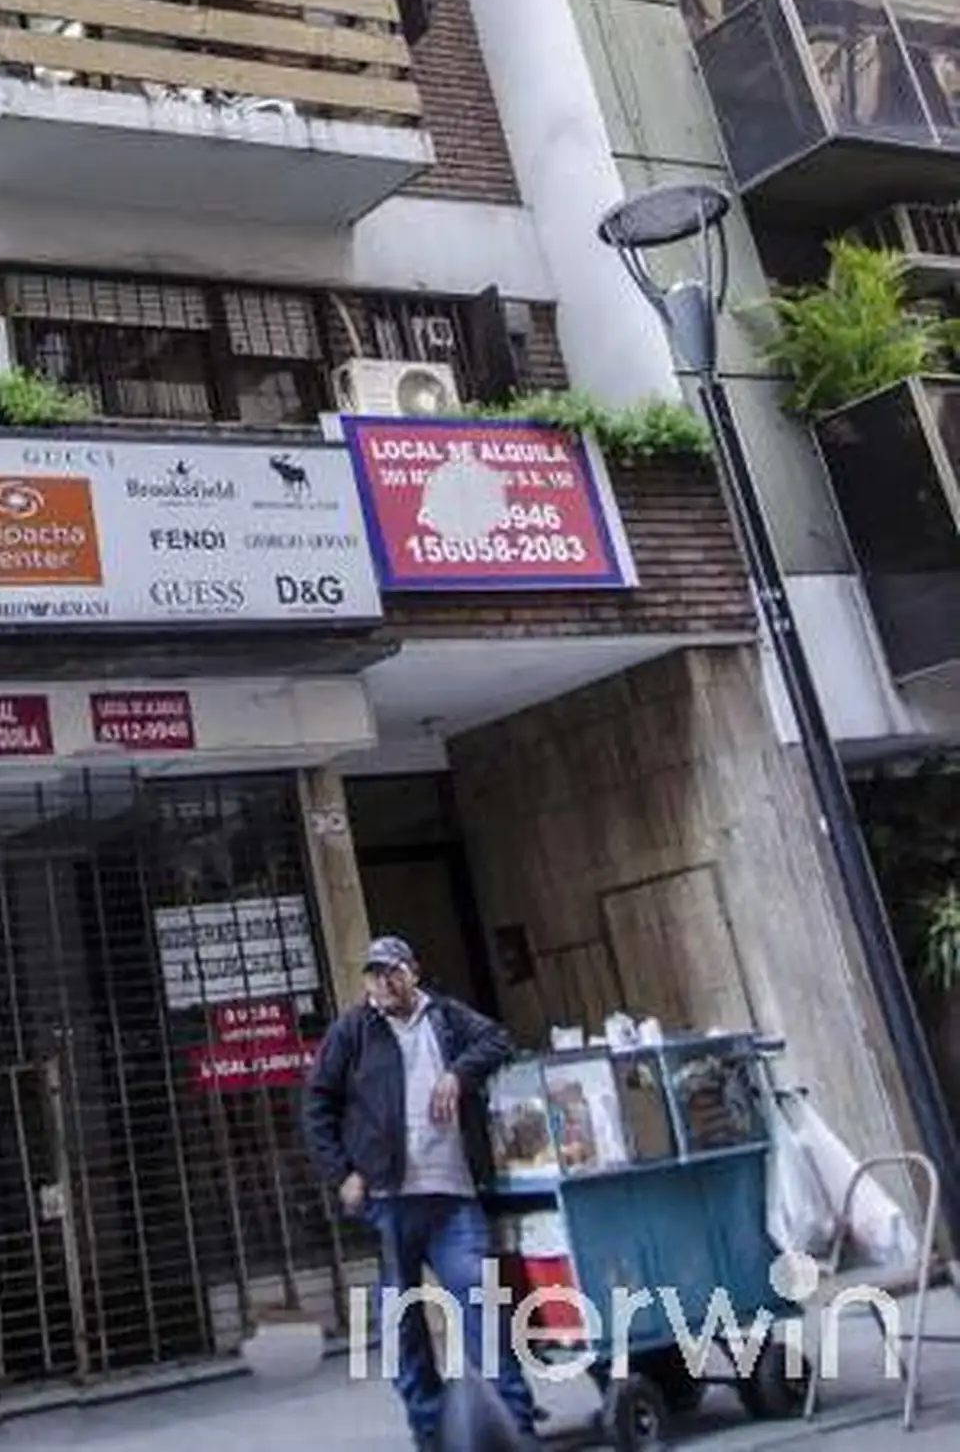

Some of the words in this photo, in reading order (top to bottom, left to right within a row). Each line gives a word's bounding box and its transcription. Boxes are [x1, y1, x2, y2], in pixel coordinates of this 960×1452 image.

[369, 437, 443, 461] LOCAL
[480, 442, 569, 463] ALQUILA
[150, 528, 226, 550] FENDI
[405, 534, 587, 564] 156058-2083
[149, 580, 245, 608] GUESS
[275, 573, 344, 605] D&G
